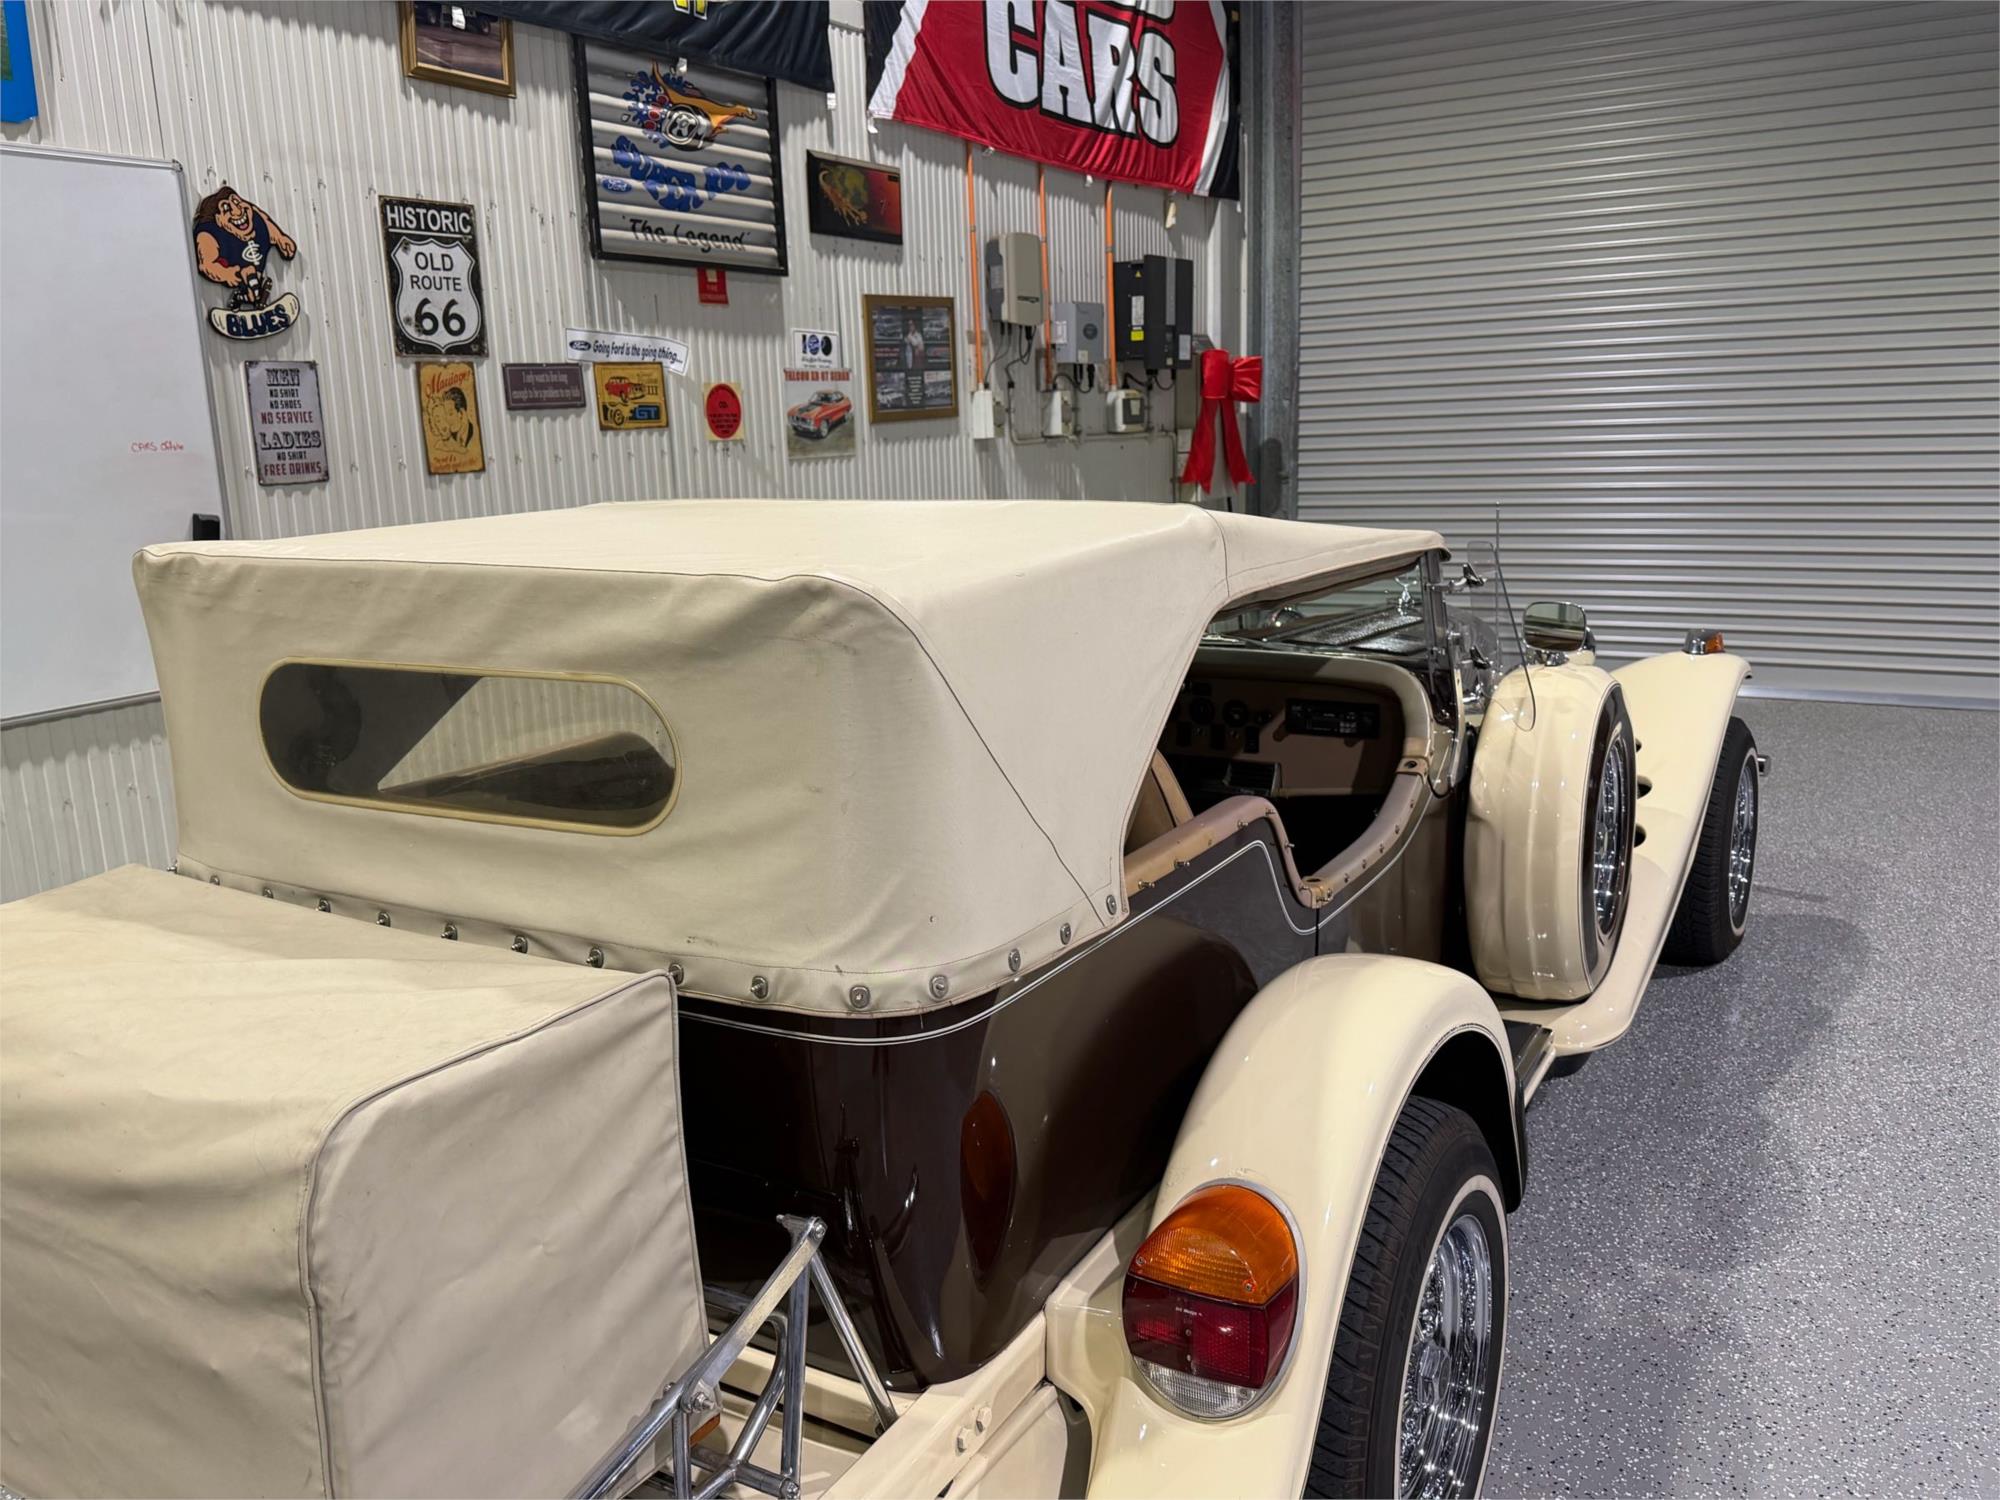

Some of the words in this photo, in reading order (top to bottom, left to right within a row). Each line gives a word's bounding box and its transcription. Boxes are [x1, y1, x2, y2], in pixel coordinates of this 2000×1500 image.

[985, 0, 1180, 147] CARS
[607, 177, 628, 192] Ford
[386, 204, 472, 234] HISTORIC
[414, 251, 454, 272] OLD
[410, 274, 462, 292] ROUTE
[226, 304, 291, 337] BLUES
[414, 297, 466, 337] 66
[593, 340, 610, 358] Going
[611, 342, 624, 355] Ford
[625, 344, 630, 355] is
[631, 344, 641, 356] the
[642, 345, 657, 361] going
[265, 368, 300, 386] MEN
[269, 389, 279, 398] NO
[280, 388, 299, 398] SHIRT
[647, 385, 658, 396] III
[270, 400, 279, 409] NO
[280, 400, 302, 409] SHOES
[636, 406, 658, 419] GT
[261, 412, 274, 424] NO
[276, 411, 313, 424] SERVICE
[259, 431, 322, 450] LADIES
[277, 452, 286, 461] NO
[288, 451, 307, 460] SHIRT
[264, 464, 286, 476] FREE
[289, 462, 322, 474] DRINKS
